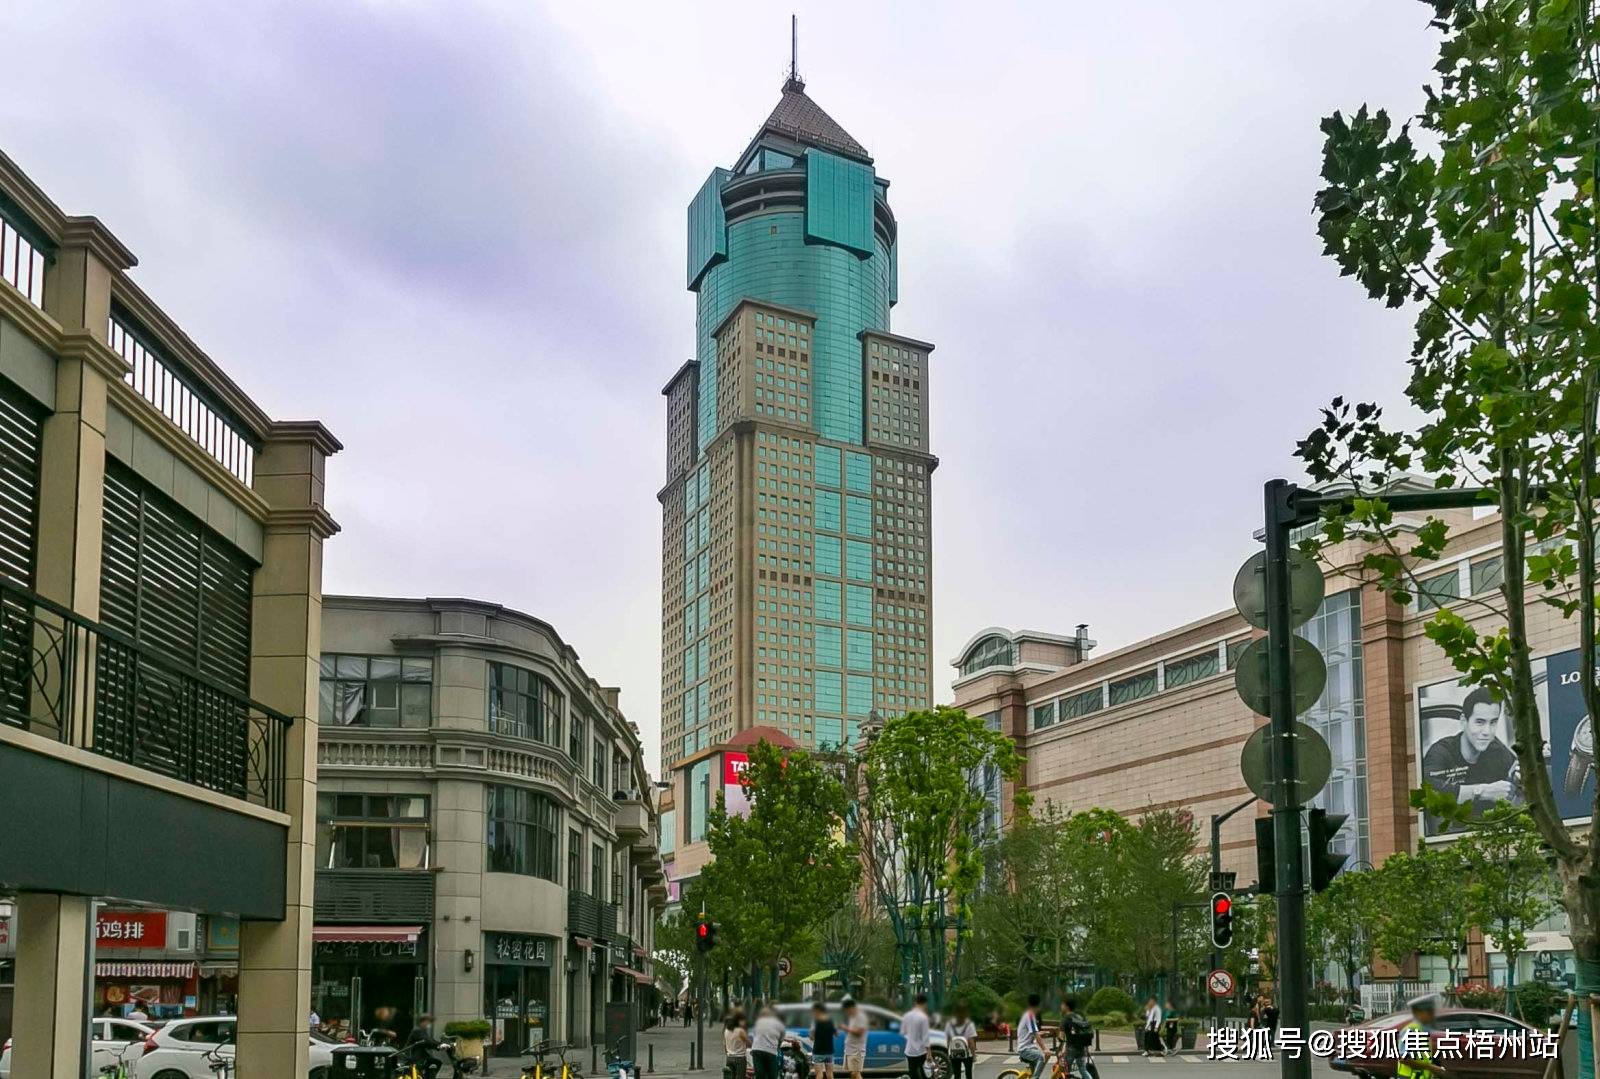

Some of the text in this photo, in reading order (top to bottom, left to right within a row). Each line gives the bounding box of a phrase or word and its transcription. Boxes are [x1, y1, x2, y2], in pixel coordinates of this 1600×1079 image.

[96, 920, 145, 939] 鸡排
[497, 938, 546, 961] 秘密花园
